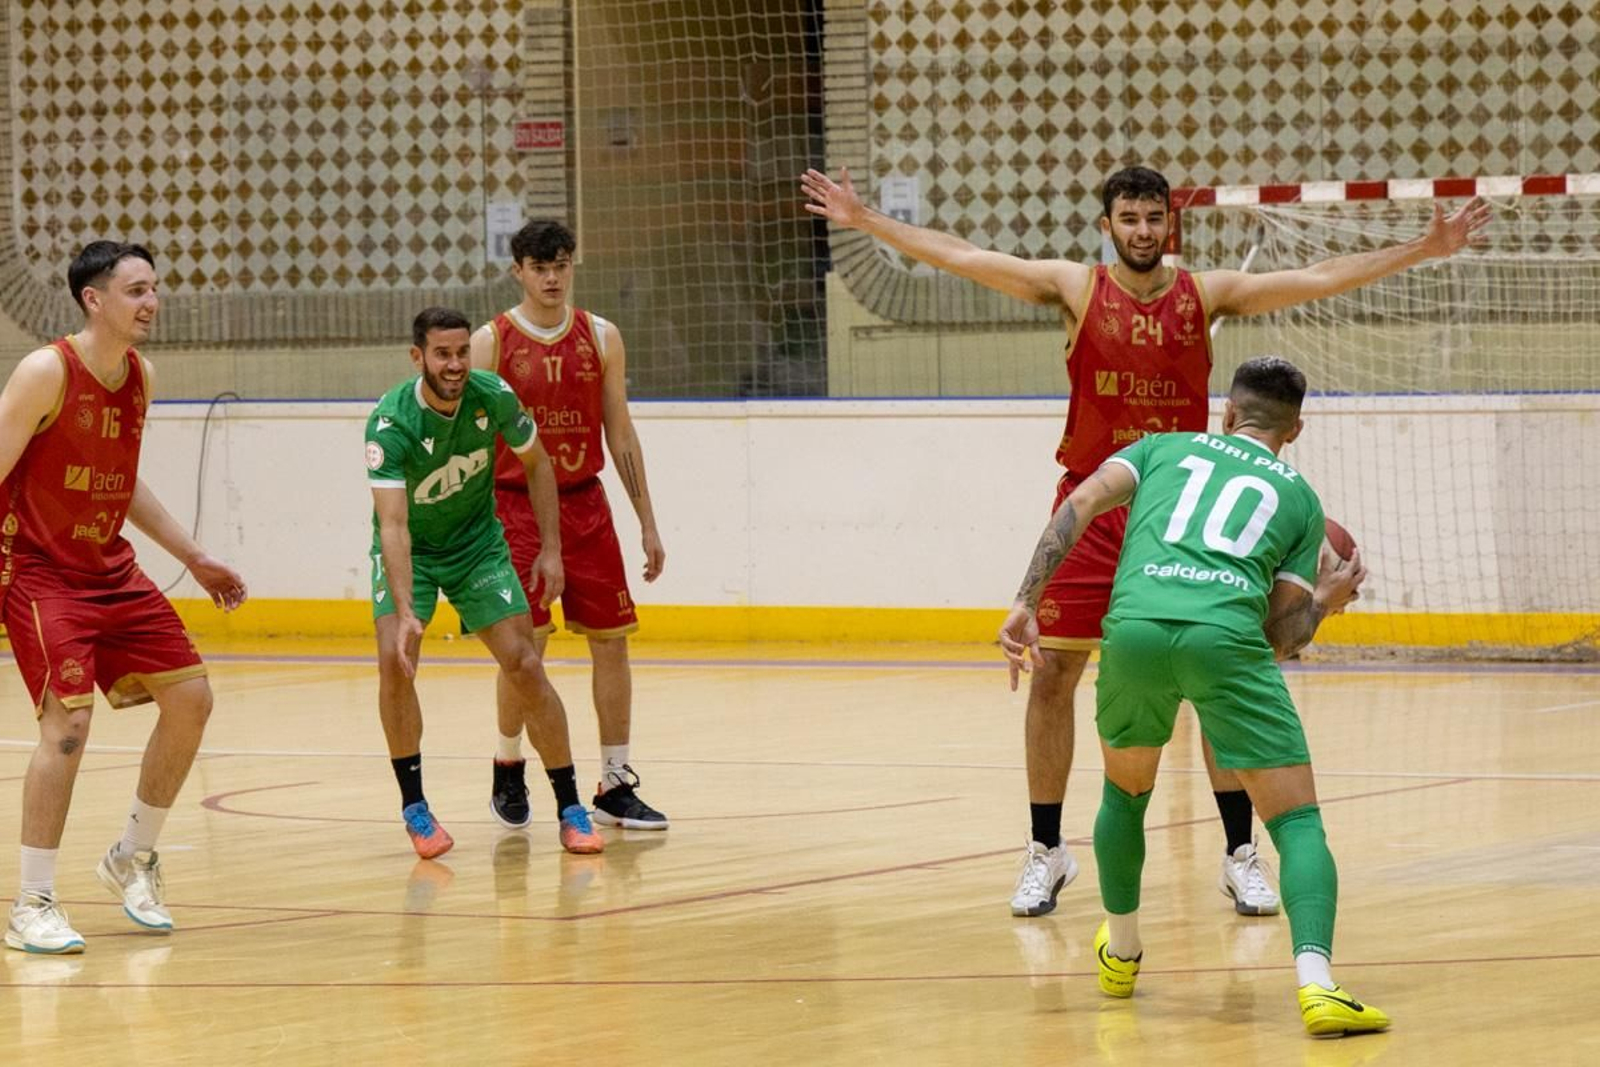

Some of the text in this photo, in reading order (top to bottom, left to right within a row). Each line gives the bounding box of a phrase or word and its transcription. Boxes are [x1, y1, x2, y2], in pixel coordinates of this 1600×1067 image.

[1131, 314, 1164, 346] 24
[542, 355, 563, 383] 17
[1121, 371, 1176, 397] Jaén
[101, 406, 122, 439] 16
[536, 405, 582, 428] Jaén
[1191, 432, 1298, 483] ADRI PAZ
[1163, 455, 1279, 558] 10
